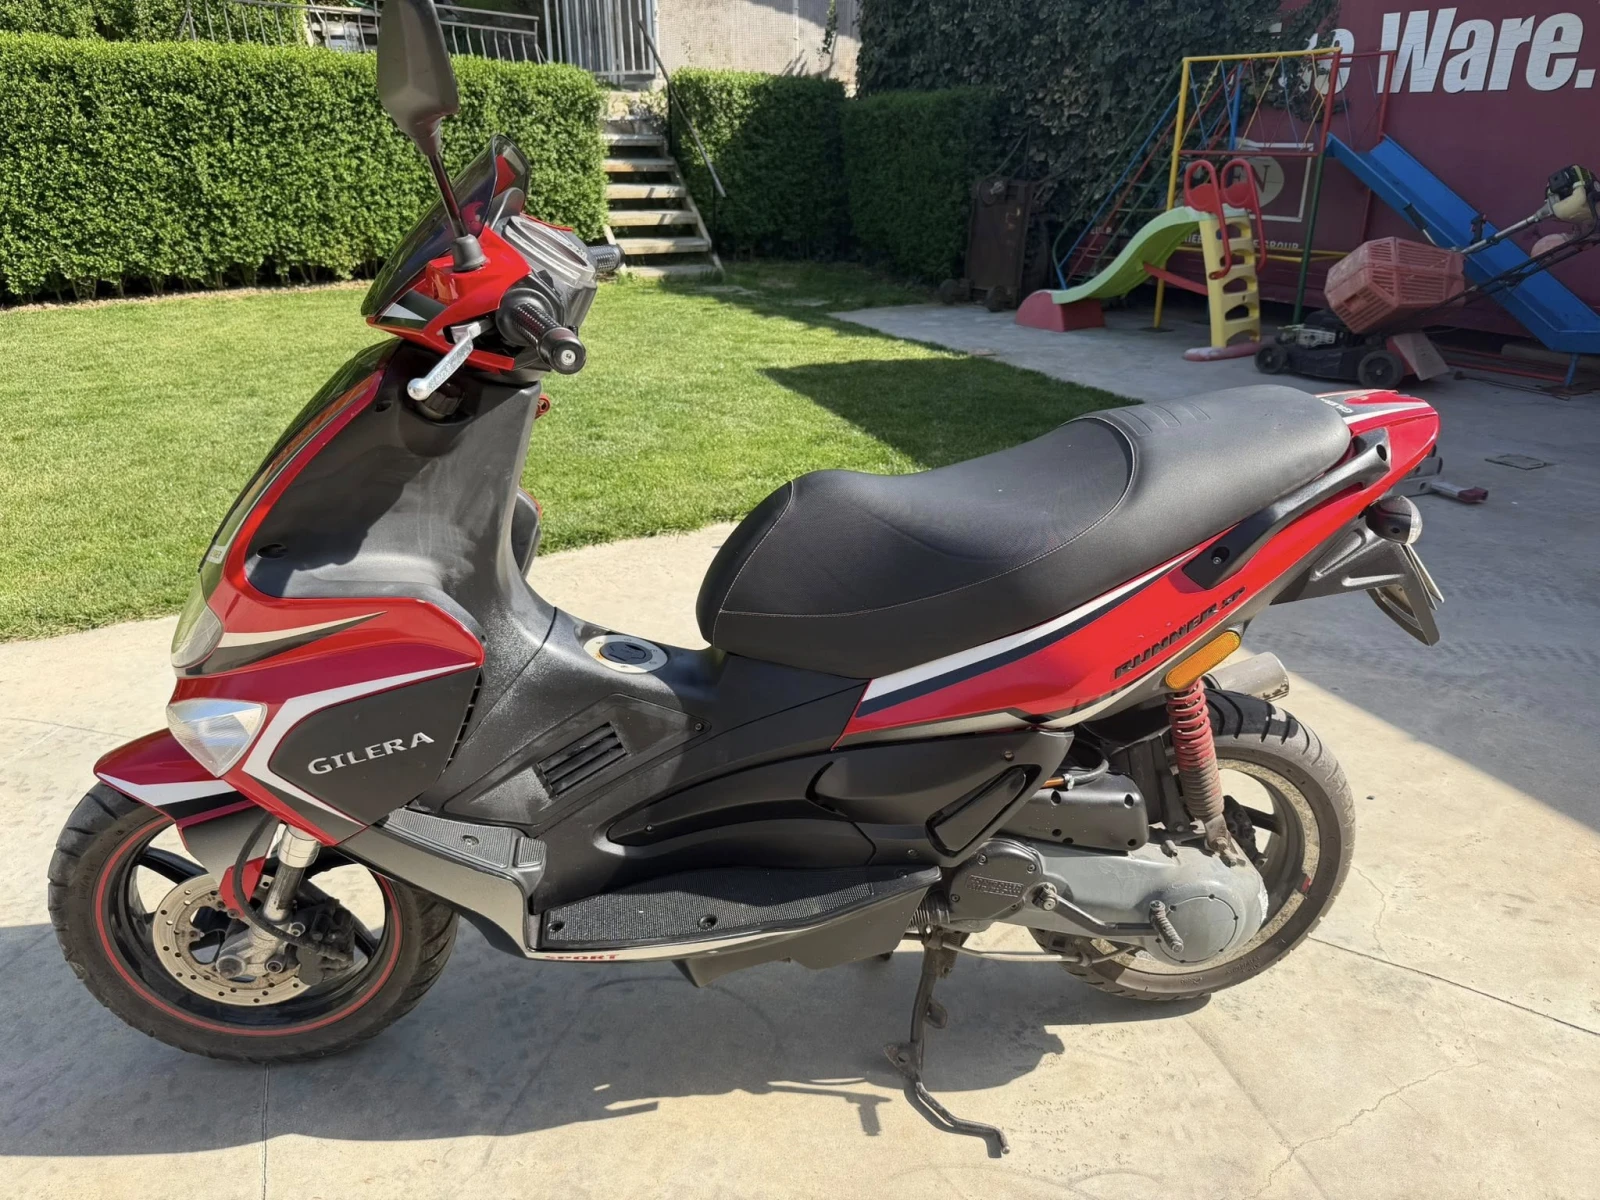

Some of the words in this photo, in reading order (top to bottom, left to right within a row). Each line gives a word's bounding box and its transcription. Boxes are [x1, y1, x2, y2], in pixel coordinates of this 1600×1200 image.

[1376, 7, 1596, 94] Ware.
[1114, 603, 1219, 680] RUNNER
[307, 732, 435, 775] GILERA
